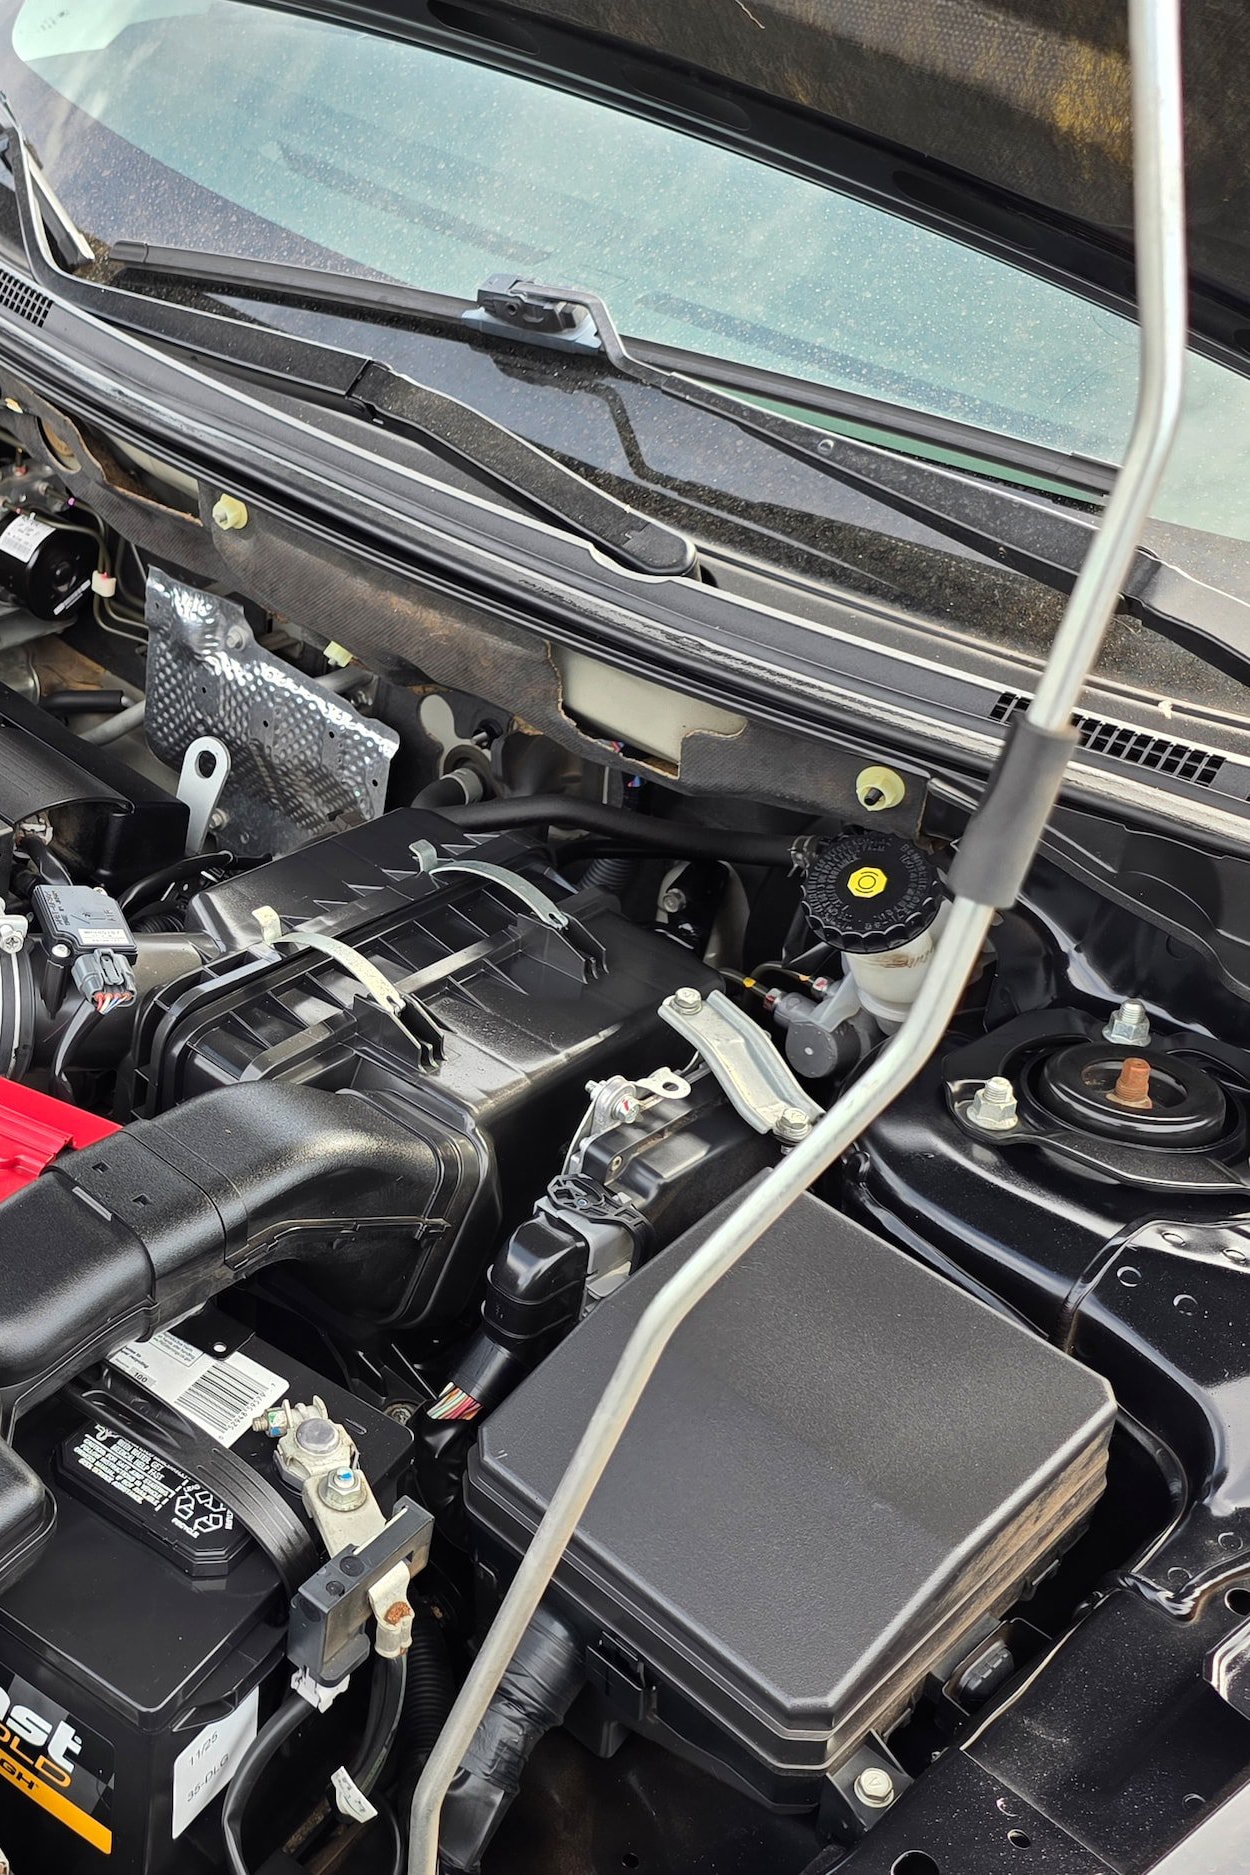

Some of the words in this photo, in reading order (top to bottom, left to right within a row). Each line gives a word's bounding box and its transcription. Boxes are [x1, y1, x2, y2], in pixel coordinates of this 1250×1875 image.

[134, 1372, 148, 1383] 100
[147, 1468, 165, 1480] FAST
[171, 1517, 200, 1539] RECYCLE
[190, 1731, 218, 1766] 11/25
[187, 1753, 229, 1802] 35-DLG
